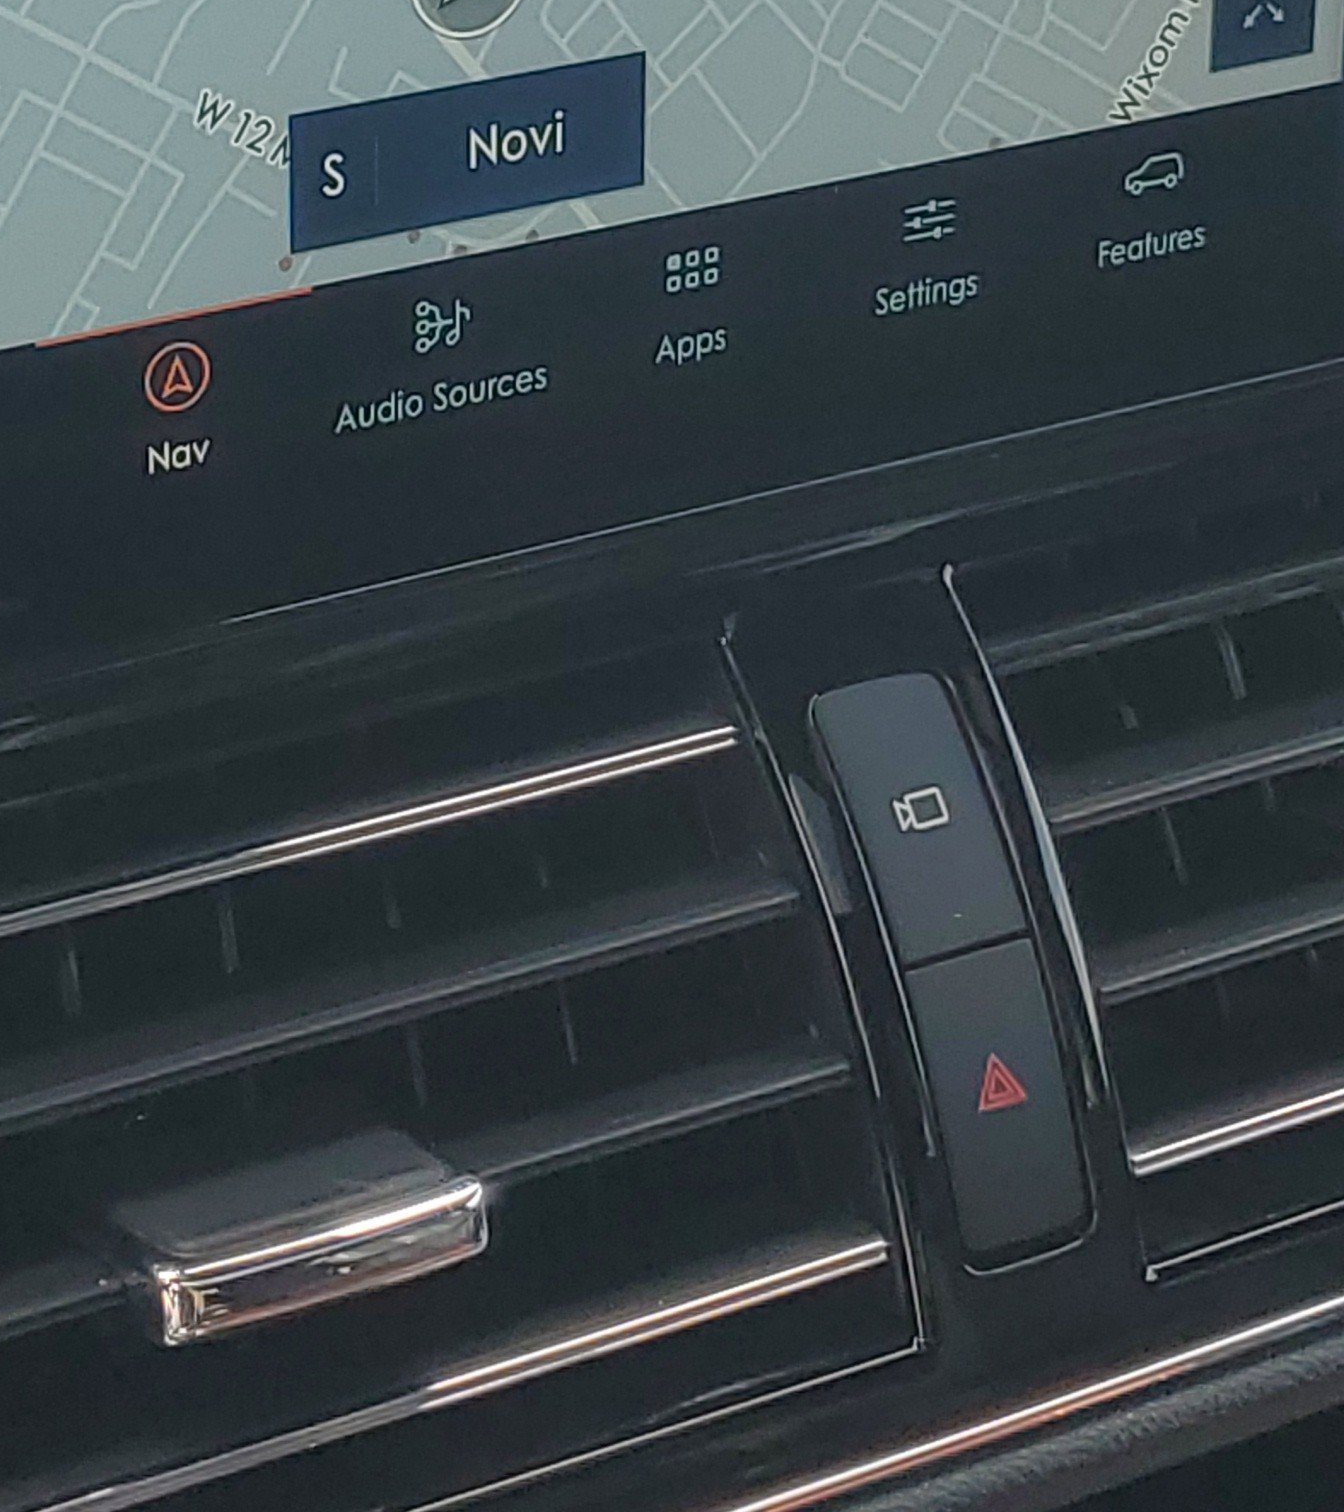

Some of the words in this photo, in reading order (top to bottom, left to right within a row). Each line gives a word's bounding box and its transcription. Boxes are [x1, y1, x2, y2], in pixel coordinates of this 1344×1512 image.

[1108, 10, 1190, 122] Wixom
[197, 91, 232, 130] W
[234, 112, 272, 154] 12
[467, 110, 566, 171] Novi
[322, 153, 346, 198] S
[1098, 225, 1207, 268] Features
[875, 273, 979, 317] Settings
[656, 326, 728, 369] Apps
[334, 388, 424, 434] Audio
[432, 362, 548, 410] Sources
[147, 437, 211, 475] Nav
